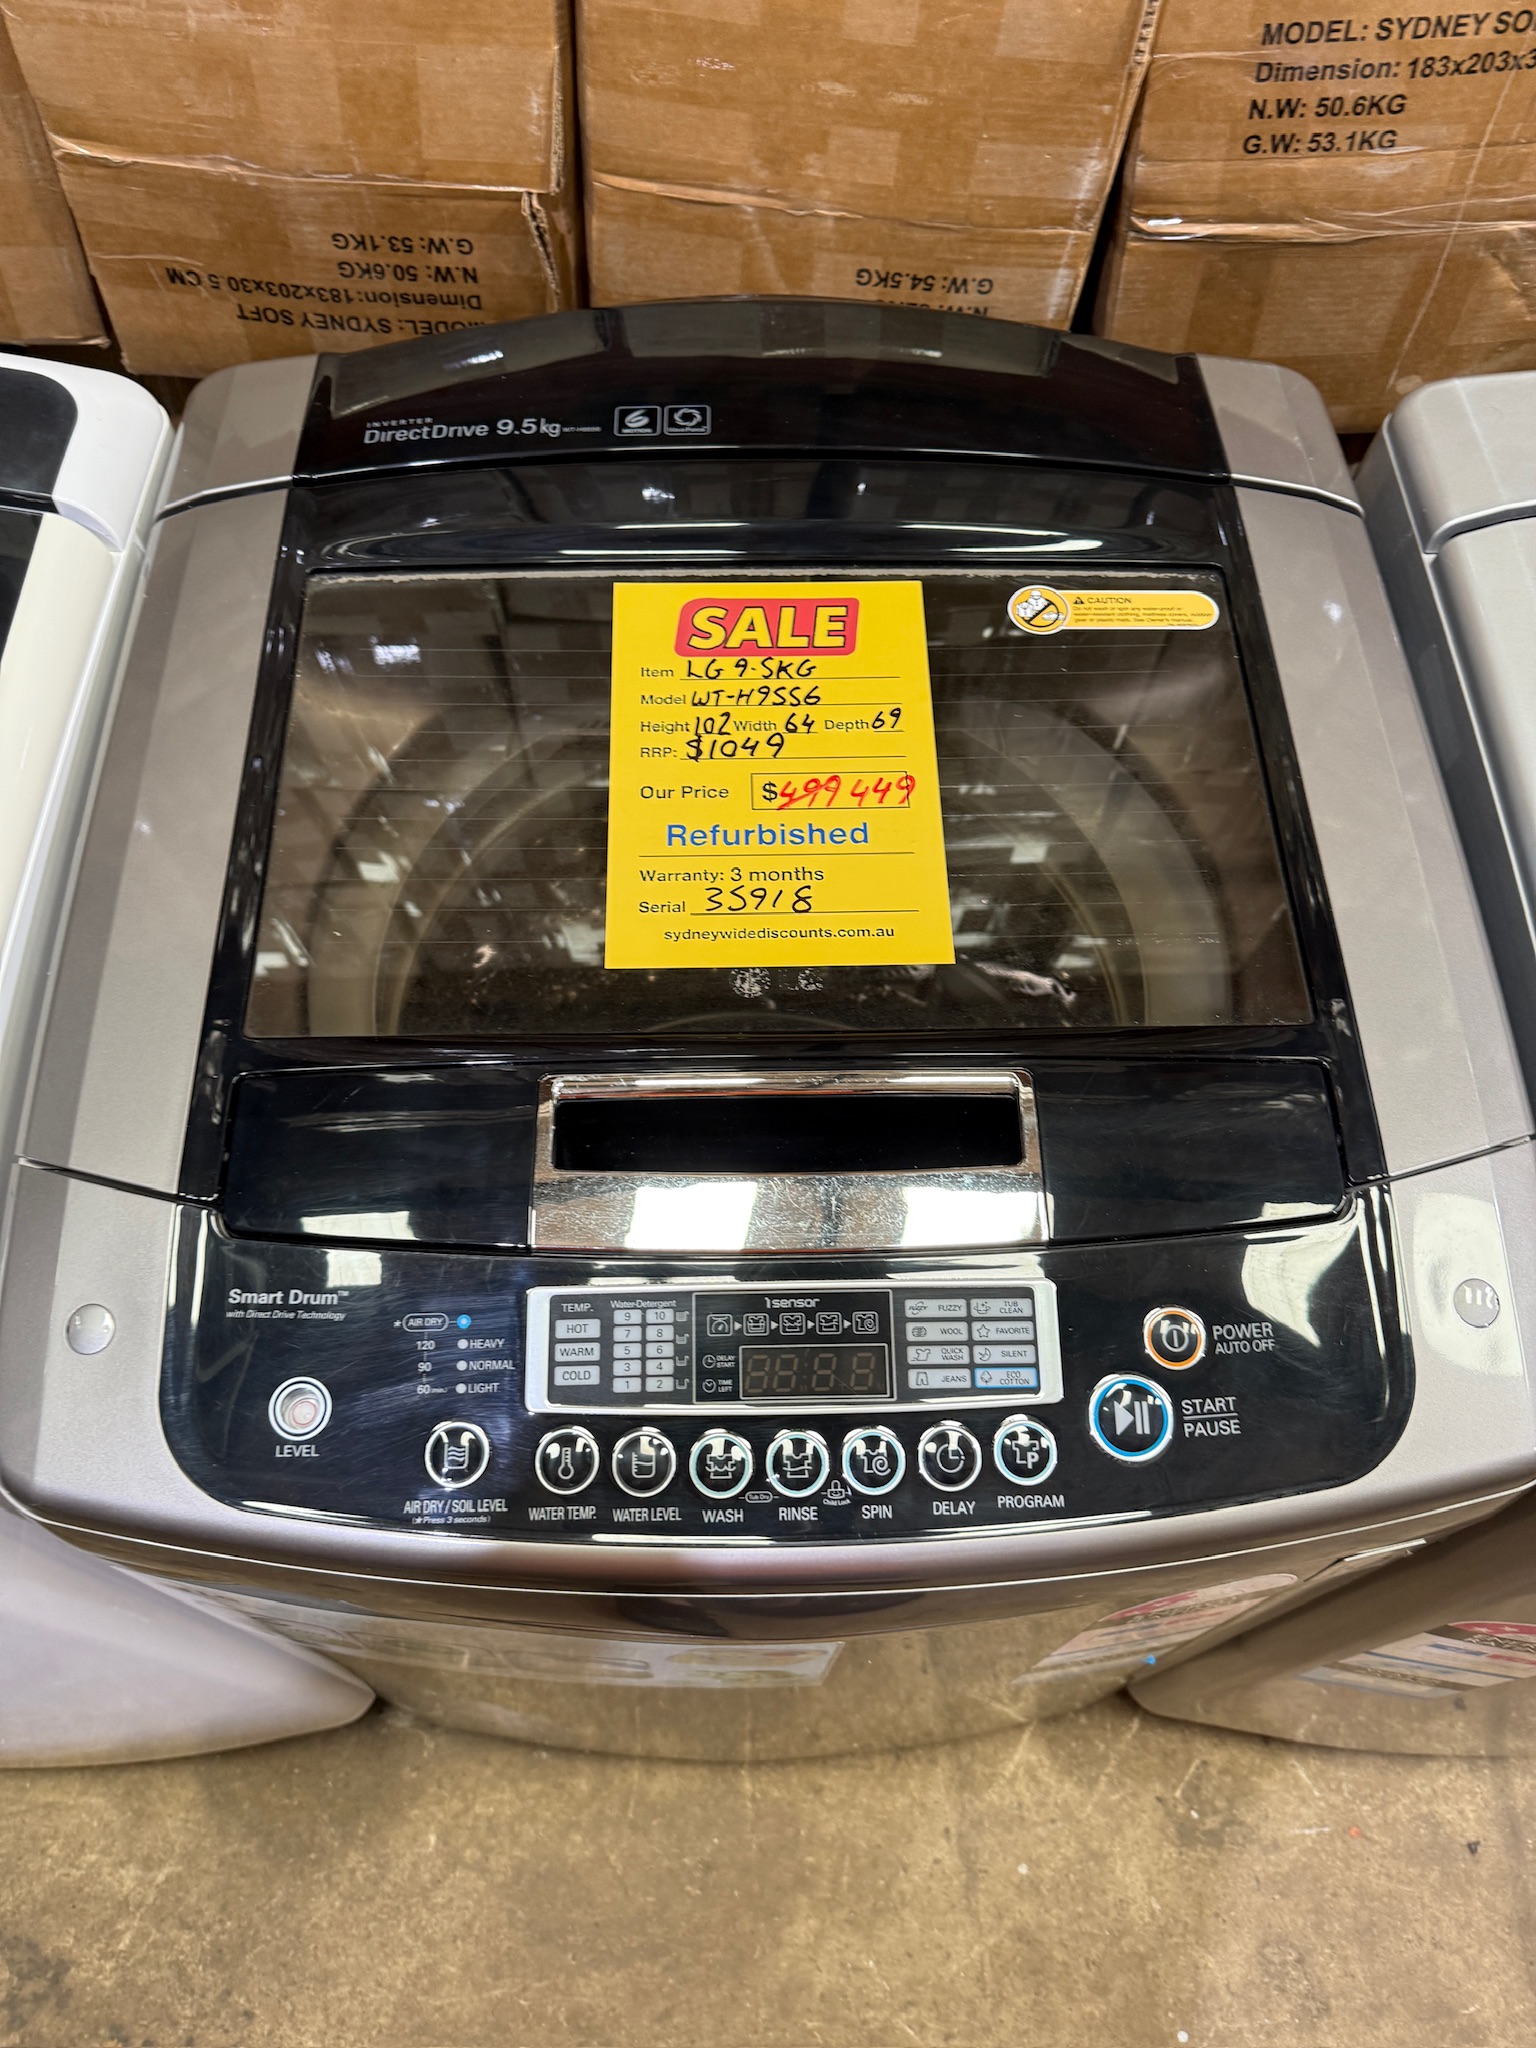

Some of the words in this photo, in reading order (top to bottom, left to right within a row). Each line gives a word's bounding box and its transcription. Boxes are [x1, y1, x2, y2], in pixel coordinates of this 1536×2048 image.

[1261, 19, 1369, 46] MODEL:
[1375, 11, 1492, 41] SYDNEY
[1493, 9, 1536, 35] SO
[1255, 57, 1401, 84] Dimension:
[1248, 97, 1307, 120] N.W:
[1314, 93, 1408, 117] 50.6KG
[1243, 132, 1301, 154] G.W:
[1306, 129, 1398, 152] 53.1KG
[331, 232, 414, 254] 53.1KG
[418, 236, 474, 255] G.W:
[166, 267, 202, 287] CM
[336, 260, 418, 282] 50.6KG
[425, 264, 480, 284] N.W:
[855, 267, 936, 292] 54.5KG
[941, 275, 994, 295] G.W:
[236, 303, 295, 326] SOFT
[301, 312, 393, 334] SYDNEY
[366, 417, 434, 428] INVERTER
[1086, 596, 1132, 604] CAUTION
[687, 605, 848, 650] SALE
[640, 666, 675, 678] Item
[686, 659, 725, 680] LG
[640, 694, 686, 706] Model
[640, 720, 690, 734] Height
[694, 712, 732, 738] 102
[733, 719, 777, 732] Width
[783, 712, 816, 733] 64
[824, 718, 869, 733] Depth
[871, 707, 902, 730] 69
[640, 747, 678, 759] RRP:
[685, 732, 785, 763] $1049
[640, 785, 675, 799] Our
[681, 785, 729, 799] Price
[849, 775, 916, 807] 449
[666, 823, 869, 847] Refurbished
[639, 868, 724, 884] Warranty:
[730, 867, 743, 882] 3
[748, 866, 825, 882] months
[638, 901, 686, 914] Serial
[663, 927, 896, 942] sydneywidediscounts.com.au
[227, 1288, 285, 1305] Smart
[561, 1303, 594, 1313] TEMP.
[937, 1304, 963, 1312] FUZZY
[245, 1309, 272, 1319] Direct
[271, 1310, 296, 1319] Drive
[296, 1310, 348, 1322] Technology
[407, 1317, 424, 1327] AIR
[424, 1317, 445, 1327] DRY
[624, 1312, 631, 1321] 9
[654, 1311, 666, 1320] 10
[566, 1323, 589, 1334] HOT
[624, 1329, 631, 1338] 7
[656, 1329, 663, 1338] 8
[939, 1327, 964, 1335] WOOL
[995, 1327, 1031, 1335] FAVORITE
[1212, 1322, 1275, 1340] POWER
[416, 1340, 436, 1350] 120
[469, 1338, 506, 1349] HEAVY
[656, 1345, 663, 1354] 6
[1214, 1341, 1251, 1355] AUTO
[1251, 1339, 1276, 1353] OFF
[559, 1347, 594, 1357] WARM
[624, 1346, 631, 1355] 5
[940, 1347, 964, 1355] QUICK
[1000, 1350, 1028, 1358] SILENT
[417, 1362, 433, 1372] 90
[468, 1360, 516, 1371] NORMAL
[624, 1363, 631, 1372] 3
[656, 1362, 663, 1371] 4
[562, 1370, 591, 1381] COLD
[941, 1375, 967, 1383] JEANS
[1006, 1370, 1021, 1378] ECO
[416, 1384, 431, 1395] 60
[467, 1382, 500, 1394] LIGHT
[656, 1380, 663, 1388] 2
[1180, 1396, 1238, 1415] START
[1183, 1419, 1242, 1438] PAUSE
[275, 1445, 320, 1458] LEVEL
[403, 1500, 422, 1514] AIR
[422, 1499, 445, 1514] DRY
[451, 1499, 476, 1513] SOIL
[477, 1498, 509, 1512] LEVEL
[996, 1494, 1066, 1509] PROGRAM
[528, 1507, 565, 1521] WATER
[565, 1505, 597, 1520] TEMP.
[612, 1508, 649, 1522] WATER
[650, 1507, 682, 1521] LEVEL
[778, 1506, 819, 1521] RINSE
[861, 1505, 893, 1519] SPIN
[932, 1501, 976, 1516] DELAY
[446, 1515, 453, 1524] 3
[701, 1509, 744, 1523] WASH
